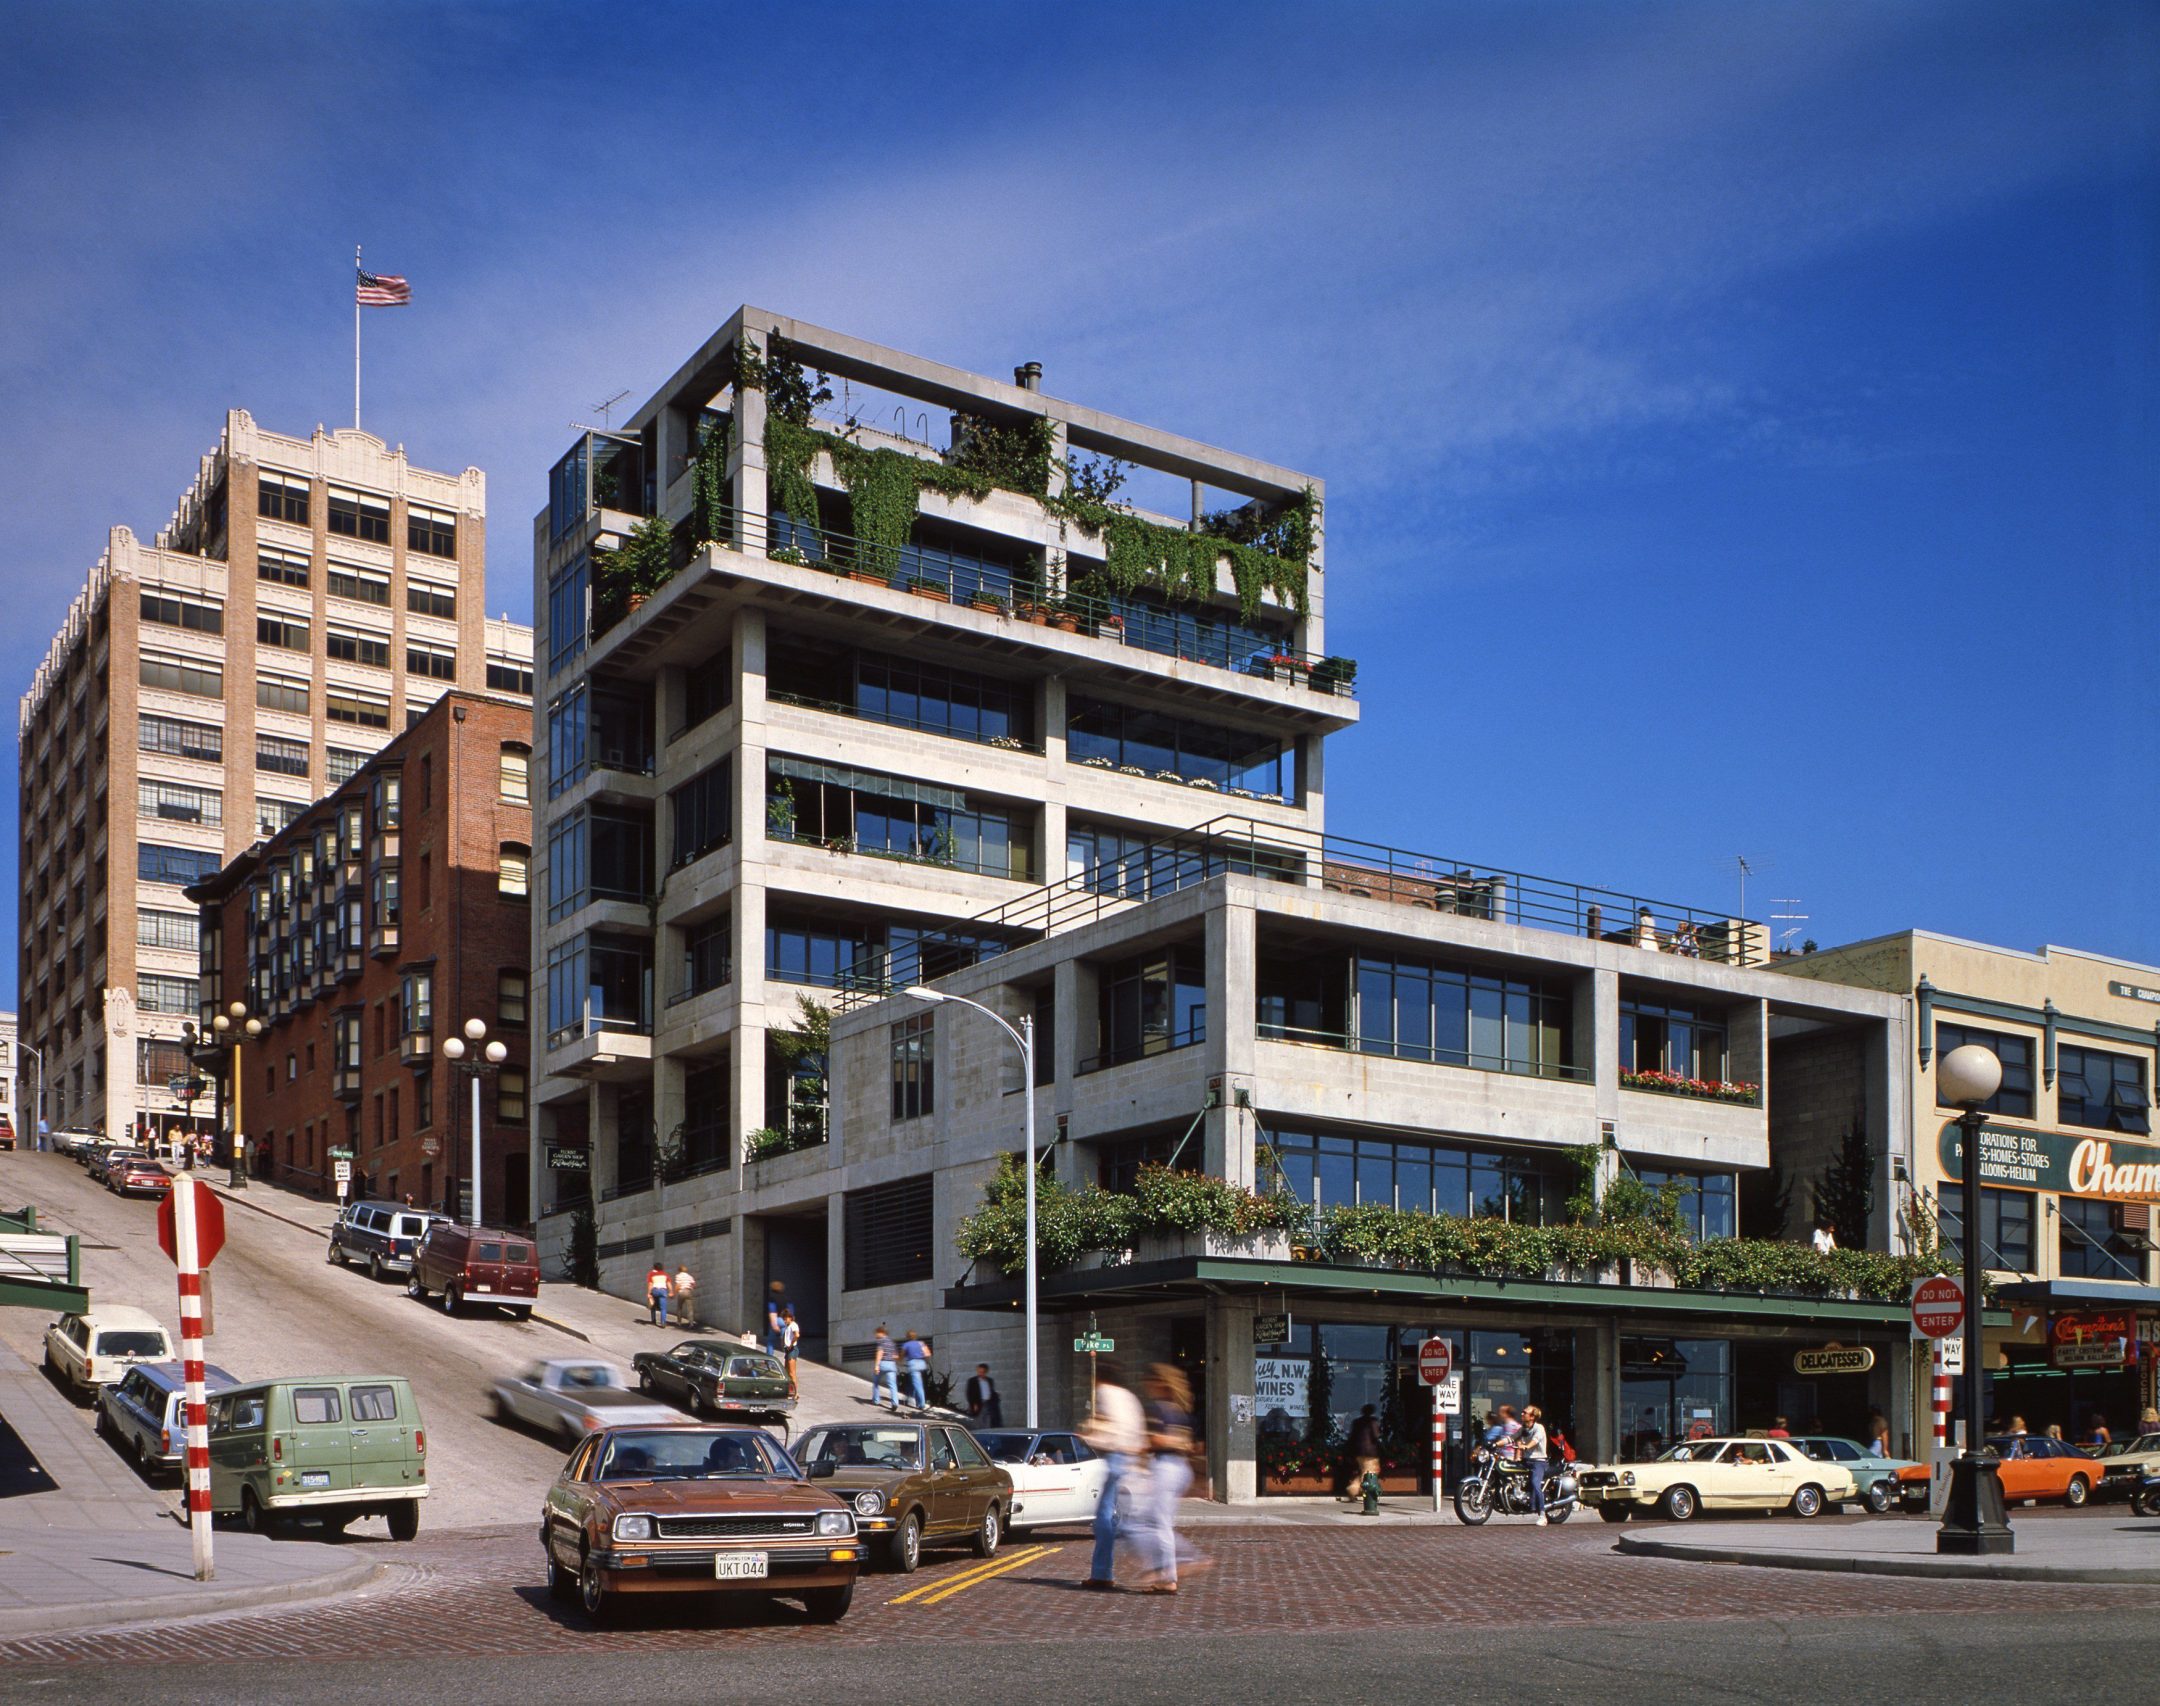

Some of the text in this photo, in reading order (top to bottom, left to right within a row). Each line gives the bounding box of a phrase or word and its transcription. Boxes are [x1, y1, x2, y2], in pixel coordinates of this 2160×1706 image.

[1980, 1132, 2037, 1152] ORATIONS FOR
[1980, 1163, 2008, 1178] LLOONS
[1922, 1289, 1957, 1300] DO NOT
[1922, 1316, 1955, 1327] ENTER
[1081, 1340, 1100, 1349] Pike
[1944, 1343, 1961, 1355] WAY
[1424, 1348, 1445, 1356] DO NOT
[1801, 1351, 1864, 1369] DELICATESSEN
[1255, 1360, 1307, 1379] uy N.W.
[1424, 1368, 1445, 1377] ENTER
[1256, 1381, 1295, 1396] WINES
[1439, 1391, 1457, 1399] WAY
[719, 1562, 764, 1576] UKT 044
